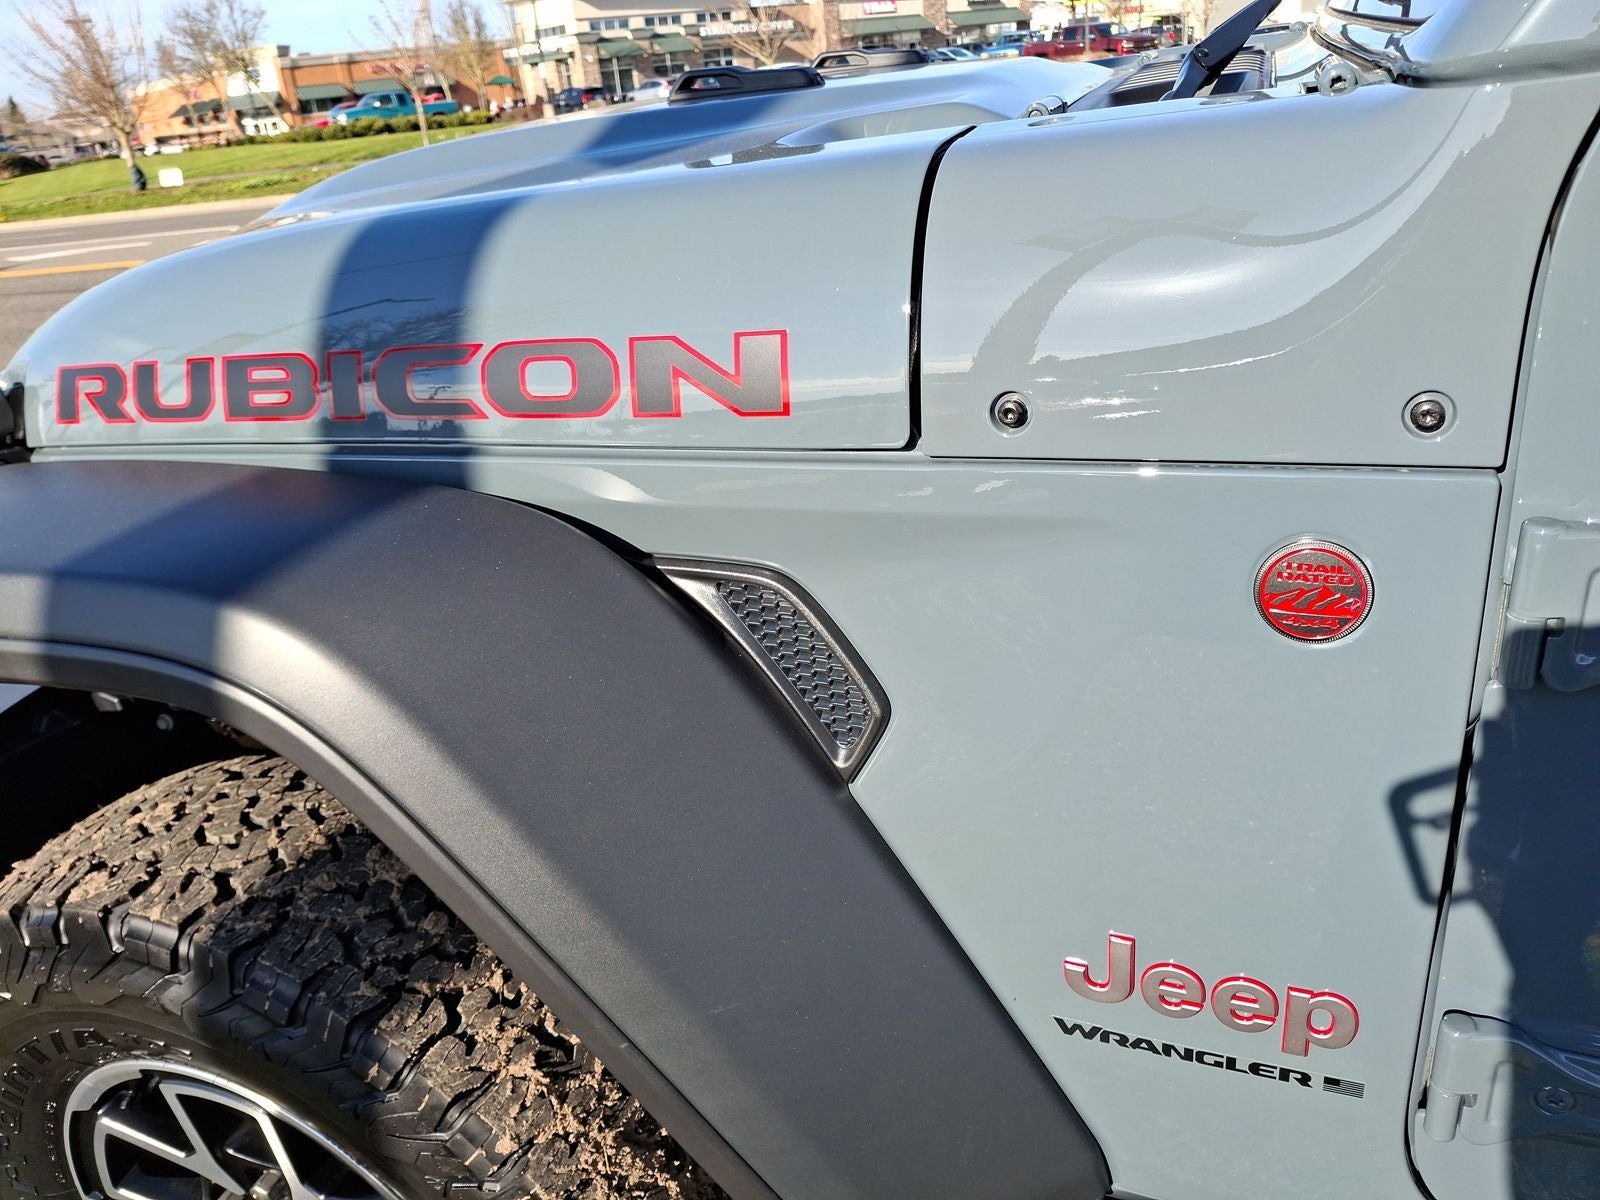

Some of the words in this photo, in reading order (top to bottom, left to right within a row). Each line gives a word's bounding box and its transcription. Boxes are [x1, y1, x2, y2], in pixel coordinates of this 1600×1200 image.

[57, 329, 791, 423] RUBICON
[1277, 572, 1355, 586] RATED
[1281, 562, 1351, 576] TRAIL
[1063, 930, 1360, 1057] Jeep
[1053, 1015, 1313, 1088] WRANGLER
